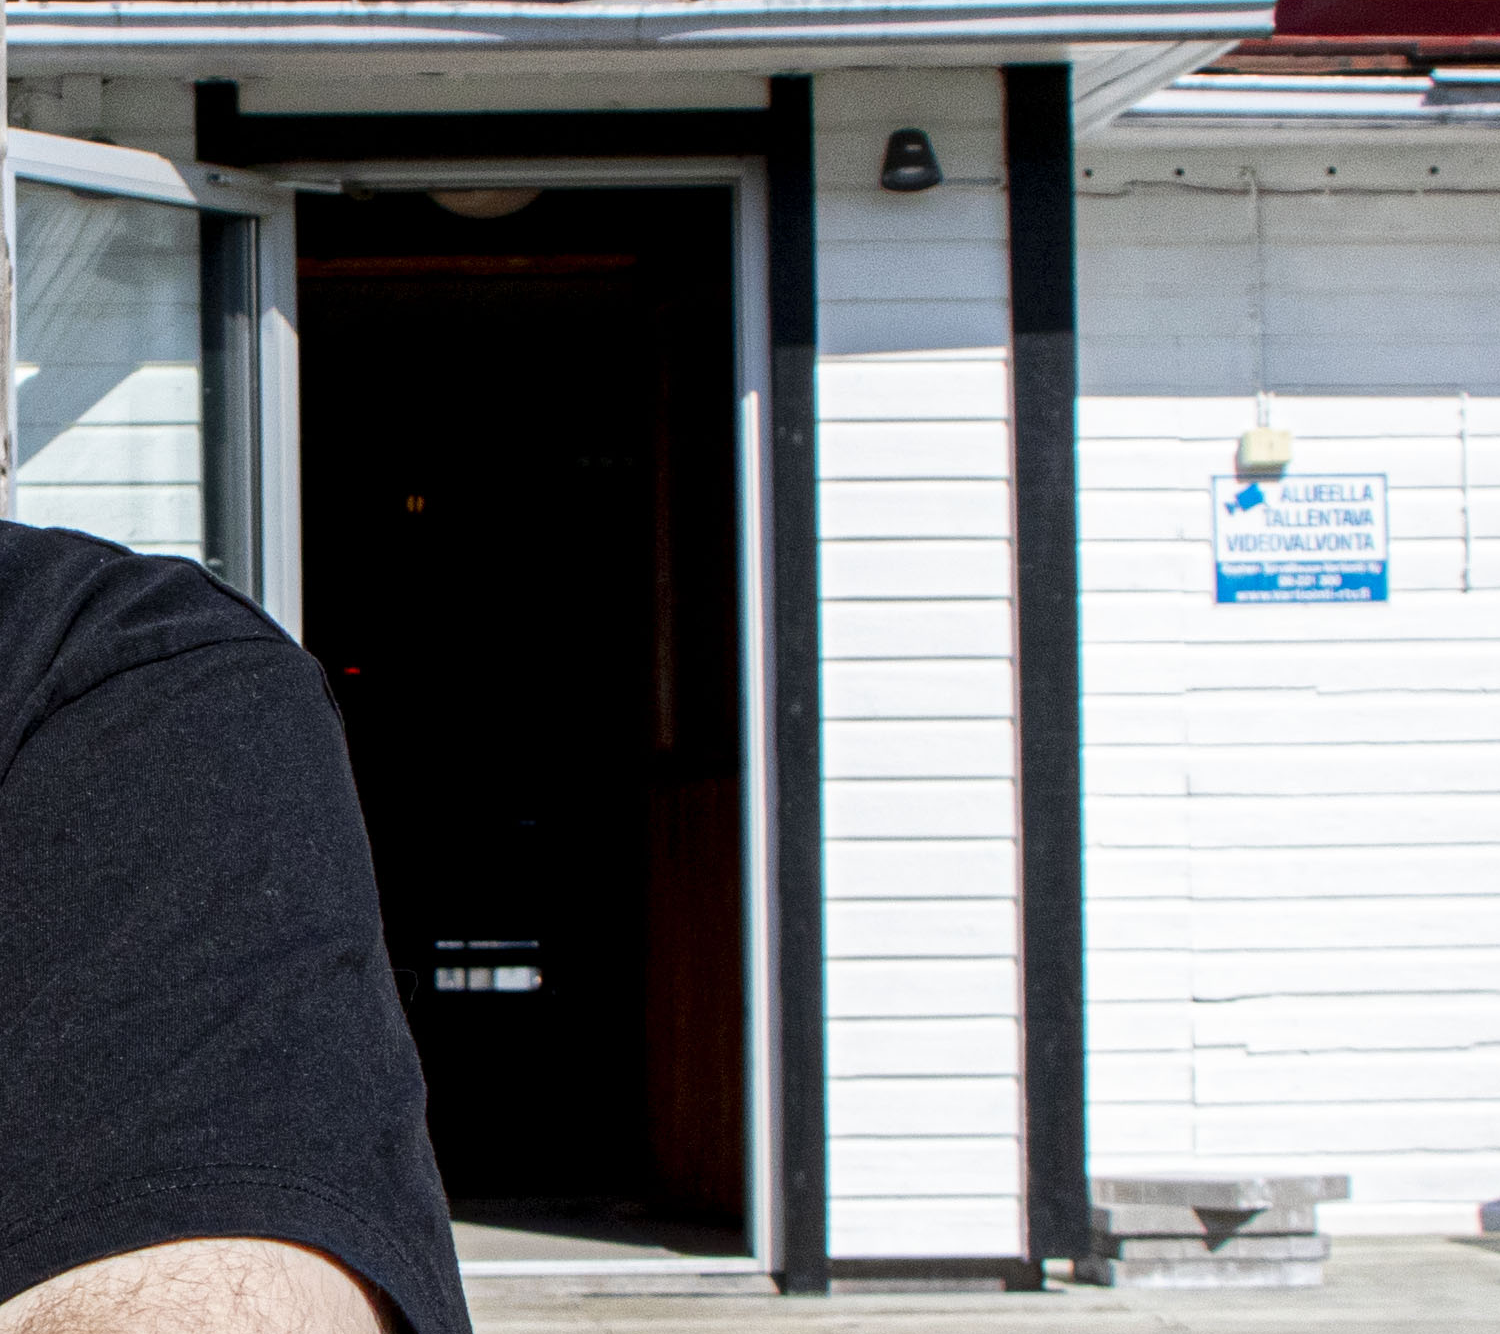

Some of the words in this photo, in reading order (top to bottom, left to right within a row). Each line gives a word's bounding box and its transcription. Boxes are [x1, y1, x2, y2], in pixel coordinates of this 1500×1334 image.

[1279, 483, 1374, 503] ALUEELLA
[1262, 508, 1374, 527] TALLENTAVA
[1224, 533, 1376, 553] VIDEOVALVONTA
